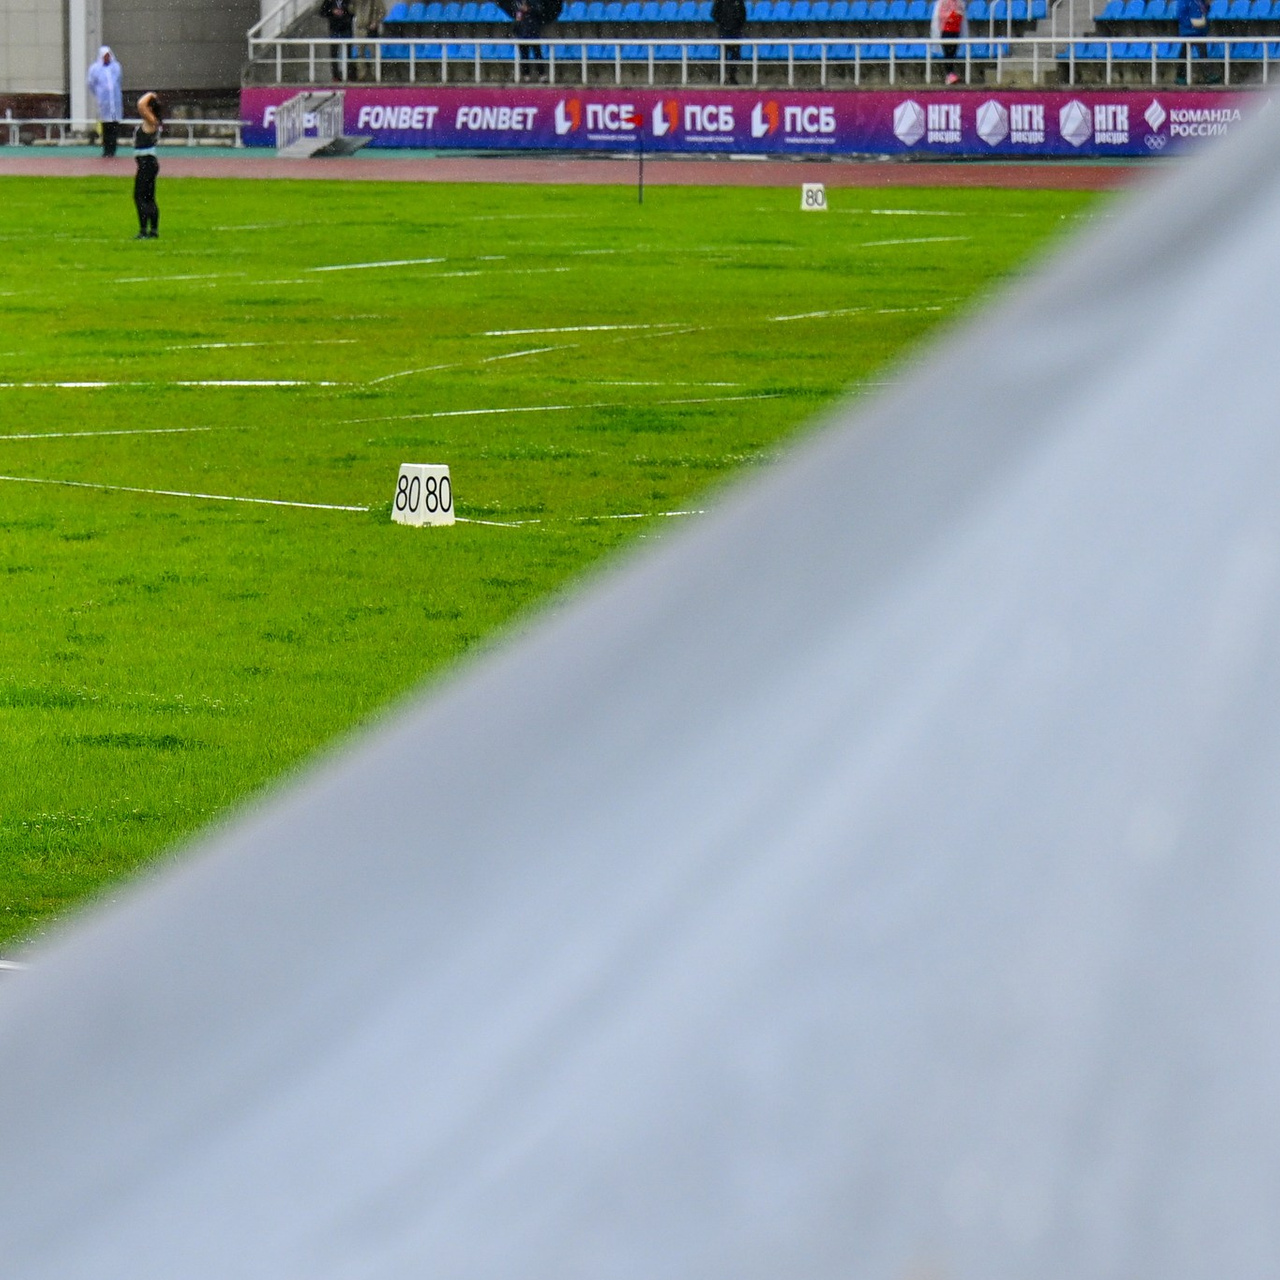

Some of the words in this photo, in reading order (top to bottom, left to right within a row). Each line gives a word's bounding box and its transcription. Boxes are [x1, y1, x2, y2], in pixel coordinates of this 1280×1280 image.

[357, 106, 438, 130] FONBET
[455, 106, 537, 130] FONBET
[685, 105, 735, 131] ПСБ
[784, 106, 836, 132] ПСБ
[928, 104, 962, 130] НГК
[1011, 104, 1045, 130] НГК
[1095, 105, 1129, 131] НГК
[1170, 109, 1241, 122] КОМАНДА
[1170, 123, 1227, 137] РОССИИ
[806, 189, 825, 207] 80
[396, 475, 420, 511] 80
[426, 476, 451, 513] 80
